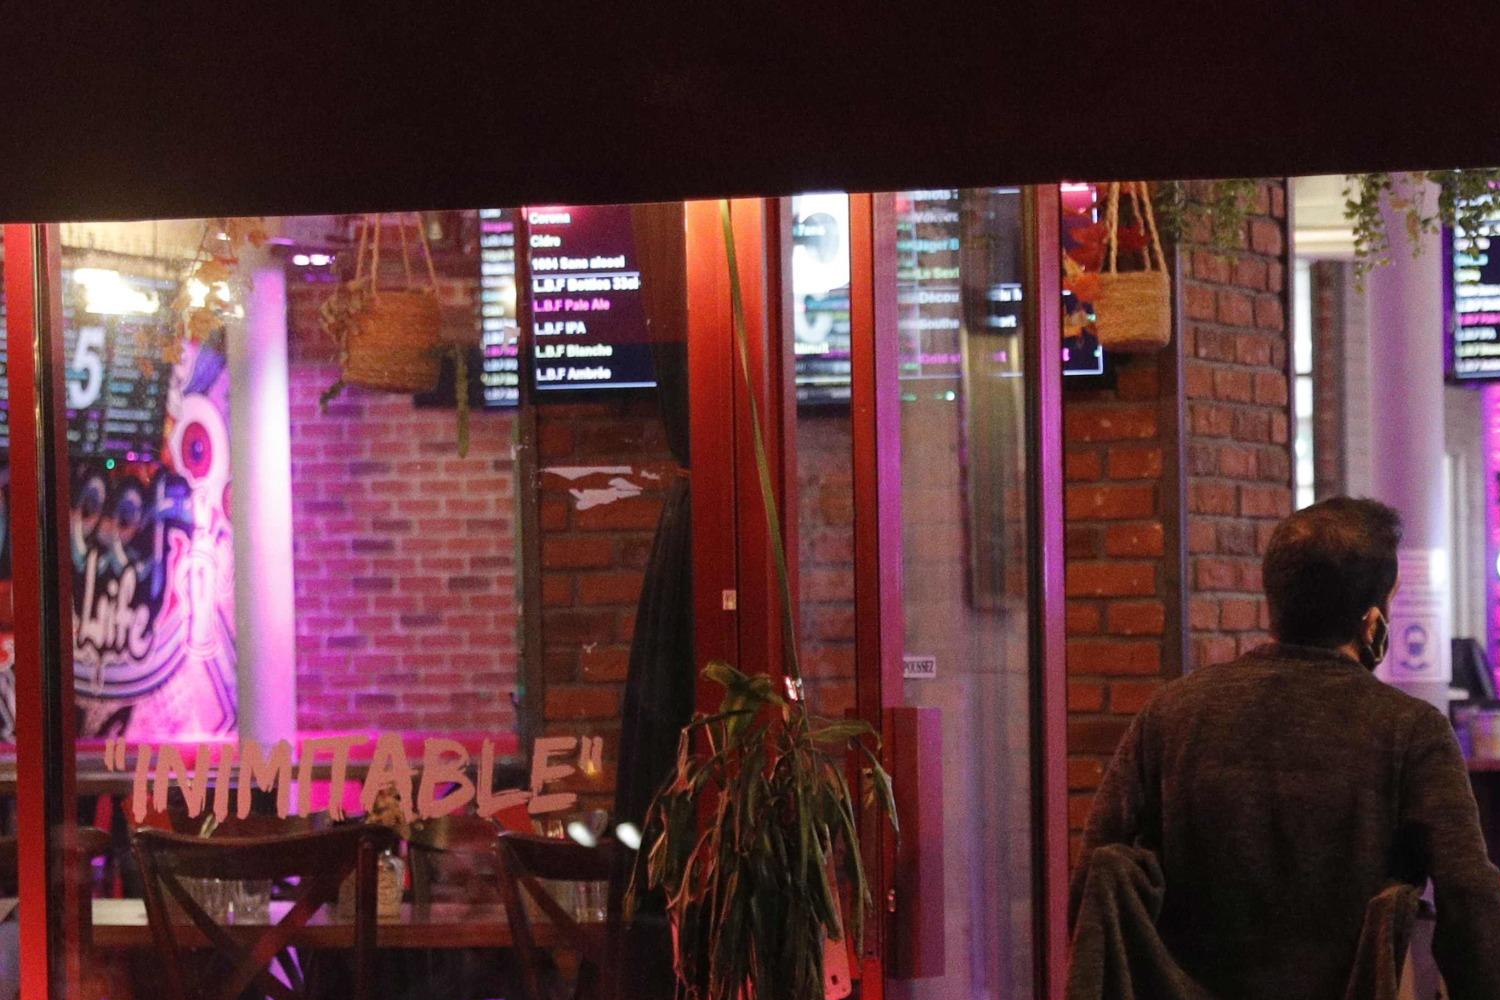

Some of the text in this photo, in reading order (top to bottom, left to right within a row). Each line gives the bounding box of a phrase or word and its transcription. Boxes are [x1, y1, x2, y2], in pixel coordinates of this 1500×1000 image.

[565, 299, 589, 311] Pale
[592, 298, 610, 310] Ale
[566, 321, 586, 334] IPA
[567, 344, 613, 357] Blanche
[67, 326, 107, 409] 5
[104, 732, 603, 823] "INIMITABLE"
